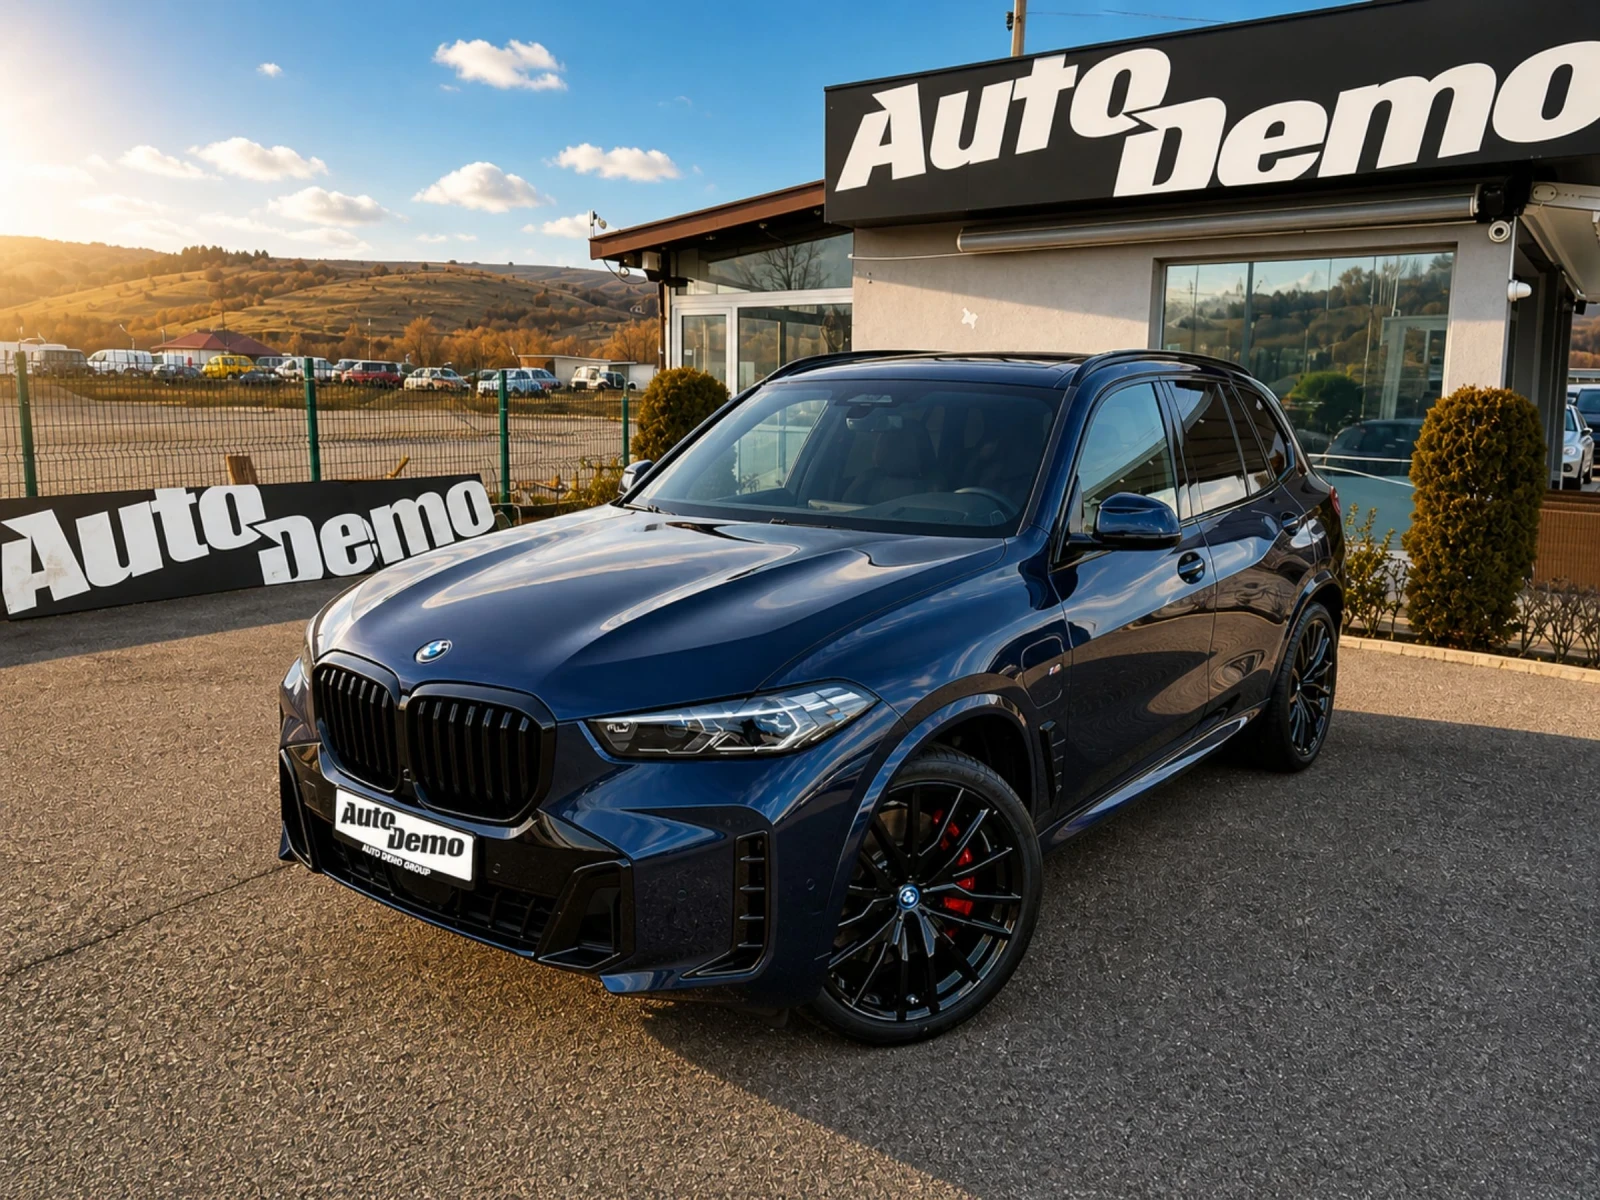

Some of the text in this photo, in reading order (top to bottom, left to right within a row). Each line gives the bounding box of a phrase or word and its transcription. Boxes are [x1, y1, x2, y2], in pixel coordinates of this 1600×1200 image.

[835, 41, 1600, 197] Auto Demo
[1, 480, 496, 615] Auto Demo
[340, 801, 465, 858] Auto Demo
[361, 843, 381, 857] AUTO
[403, 861, 431, 876] GROUP
